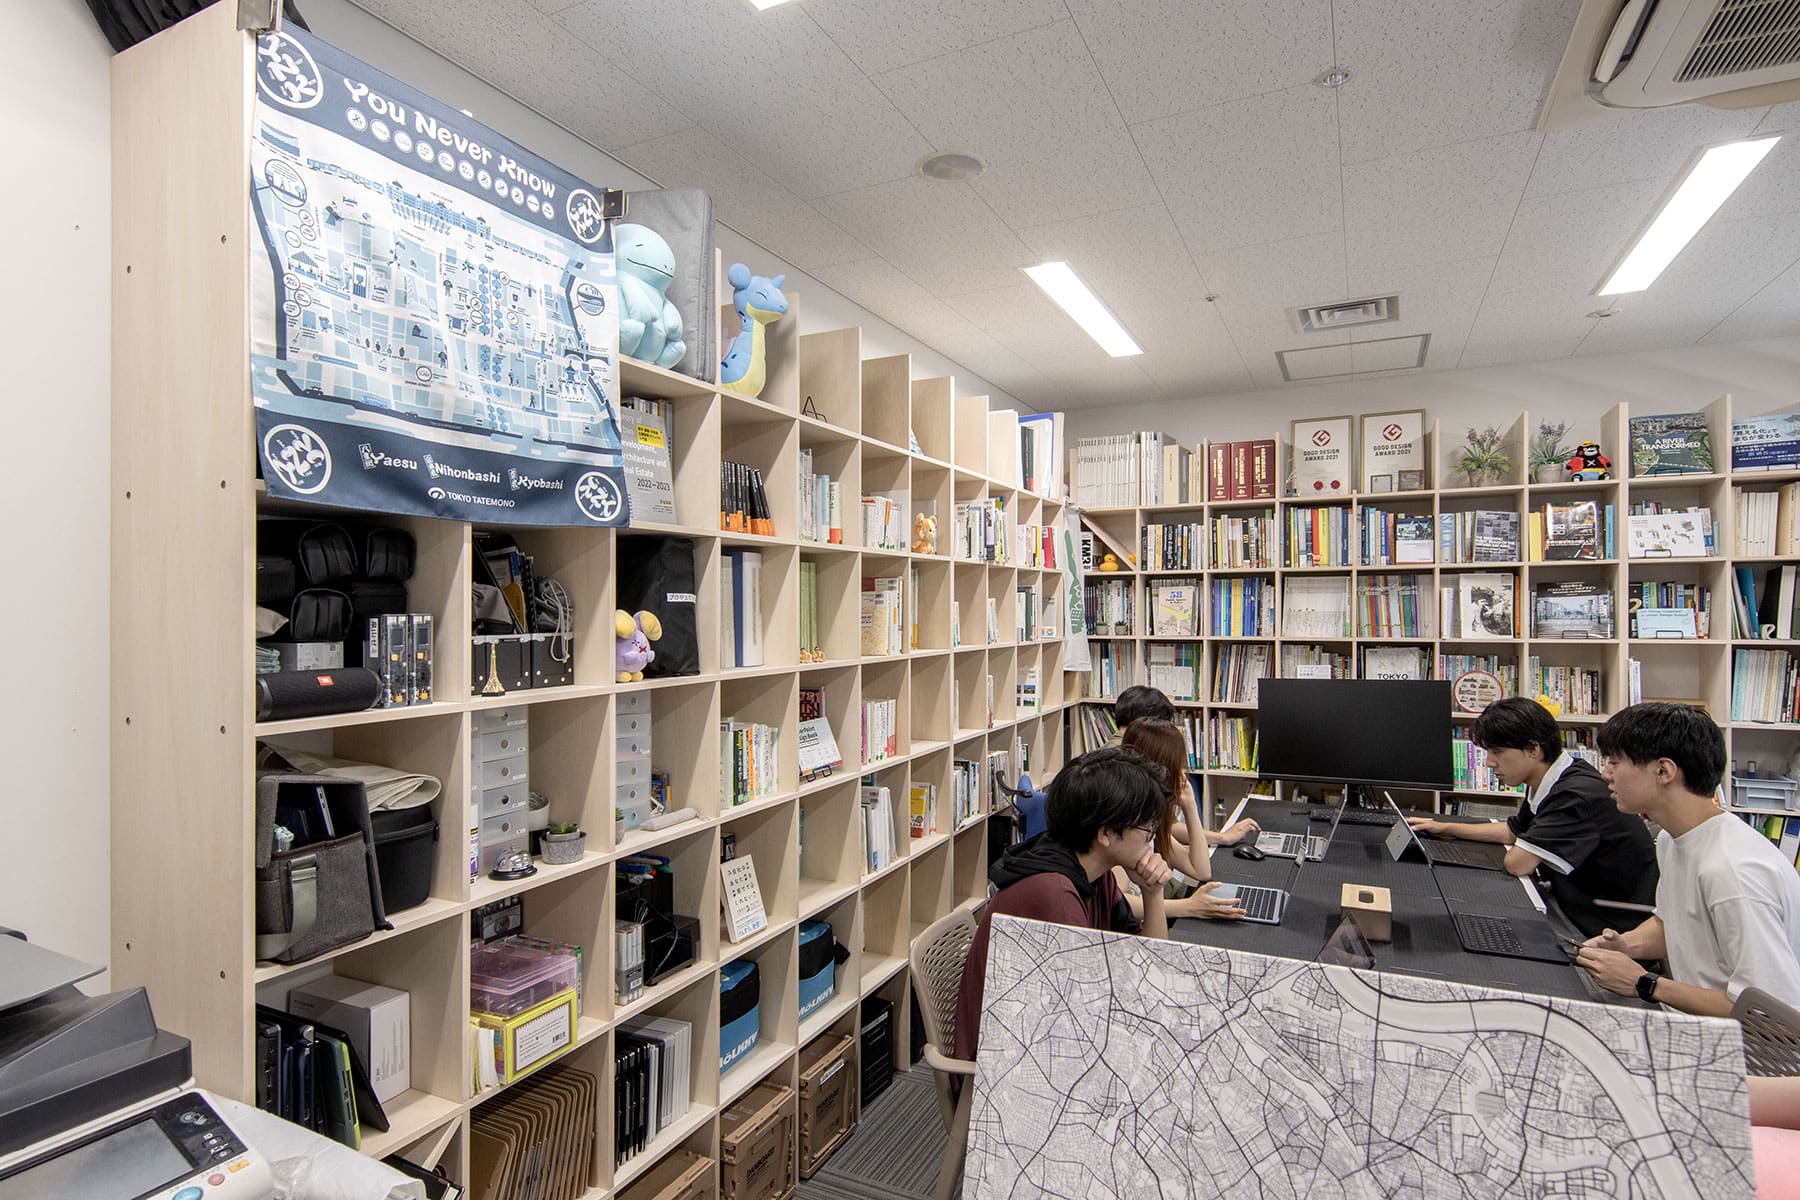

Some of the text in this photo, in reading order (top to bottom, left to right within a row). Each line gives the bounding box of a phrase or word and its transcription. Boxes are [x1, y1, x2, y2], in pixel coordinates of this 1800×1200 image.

[344, 78, 556, 199] You Never Know
[1641, 441, 1700, 451] TRANSFORMED
[370, 451, 418, 471] Yaesu
[434, 462, 501, 484] Nihonbashi
[516, 475, 564, 490] Kyobashi
[446, 491, 516, 508] TOKYO TATEMONO
[1377, 673, 1409, 681] TOKYO
